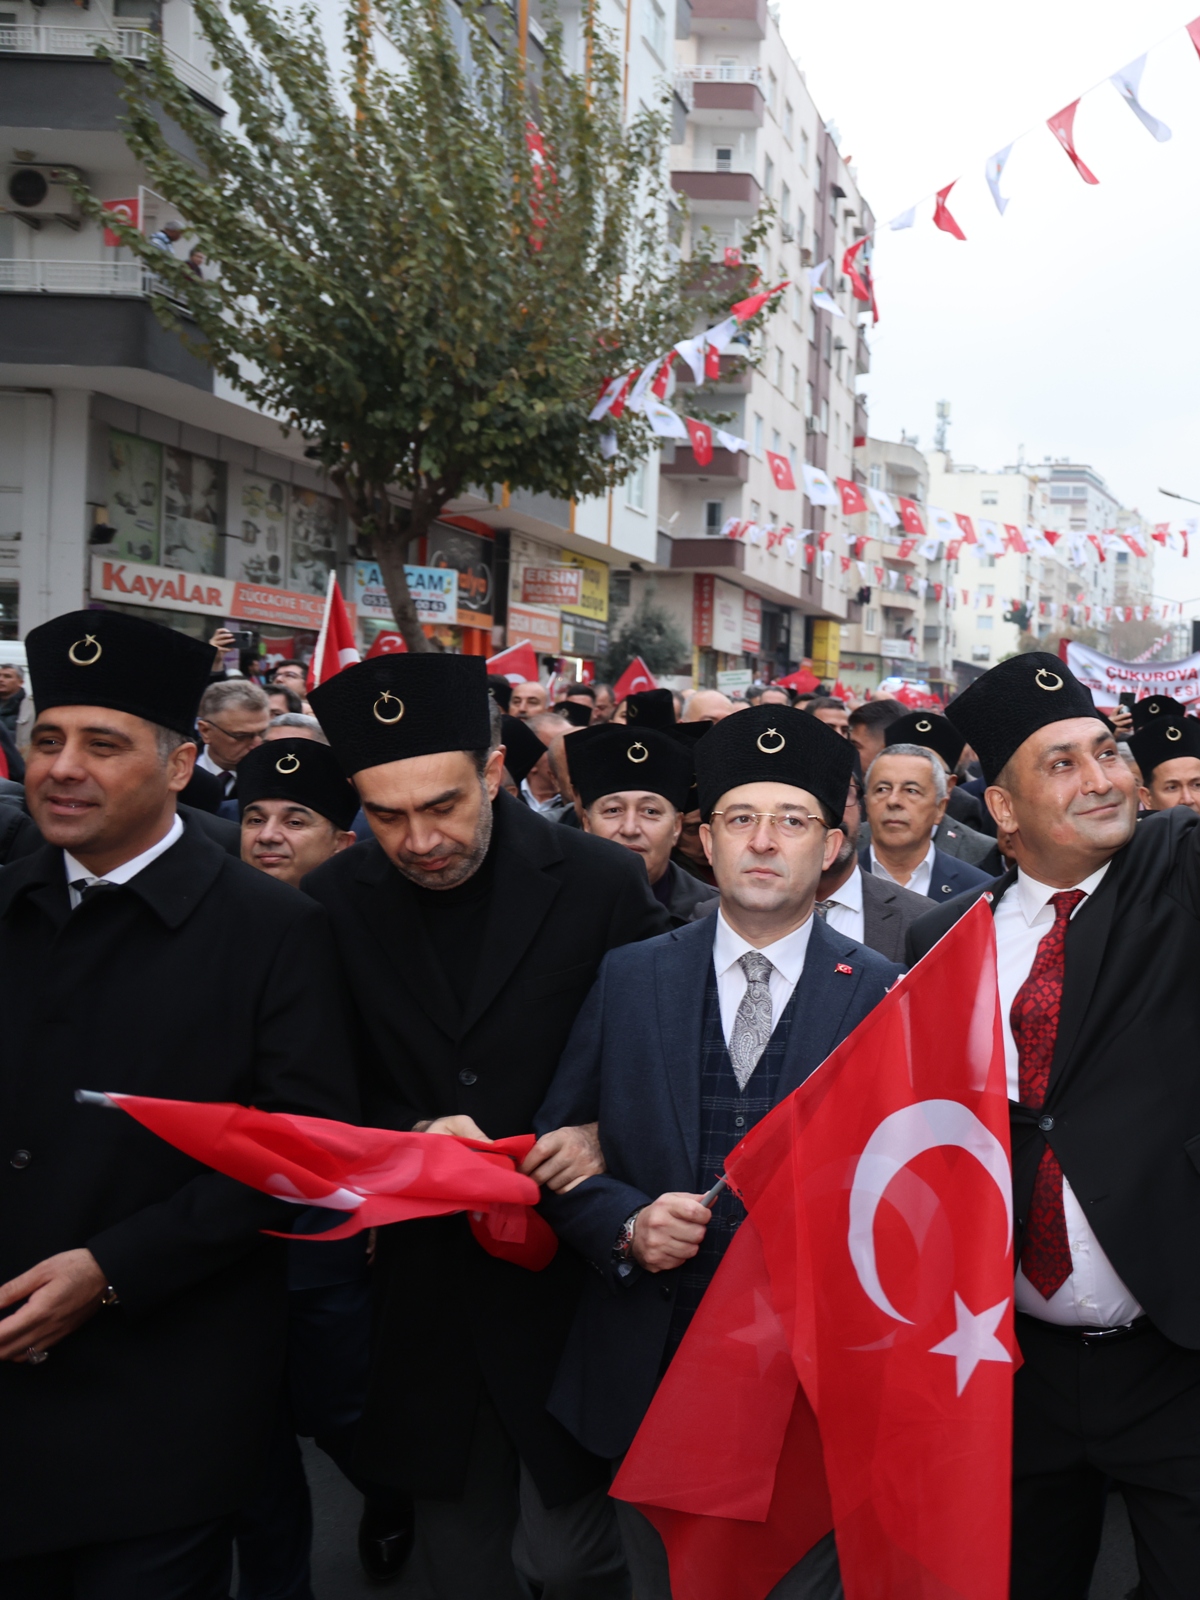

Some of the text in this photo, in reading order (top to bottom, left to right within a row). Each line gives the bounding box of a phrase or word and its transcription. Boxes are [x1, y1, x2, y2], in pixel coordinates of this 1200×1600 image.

[102, 562, 223, 607] KAYALAR
[526, 569, 578, 584] ERSİN
[1106, 666, 1198, 682] ÇUKUROVA
[1106, 681, 1200, 697] MAHALLESİ
